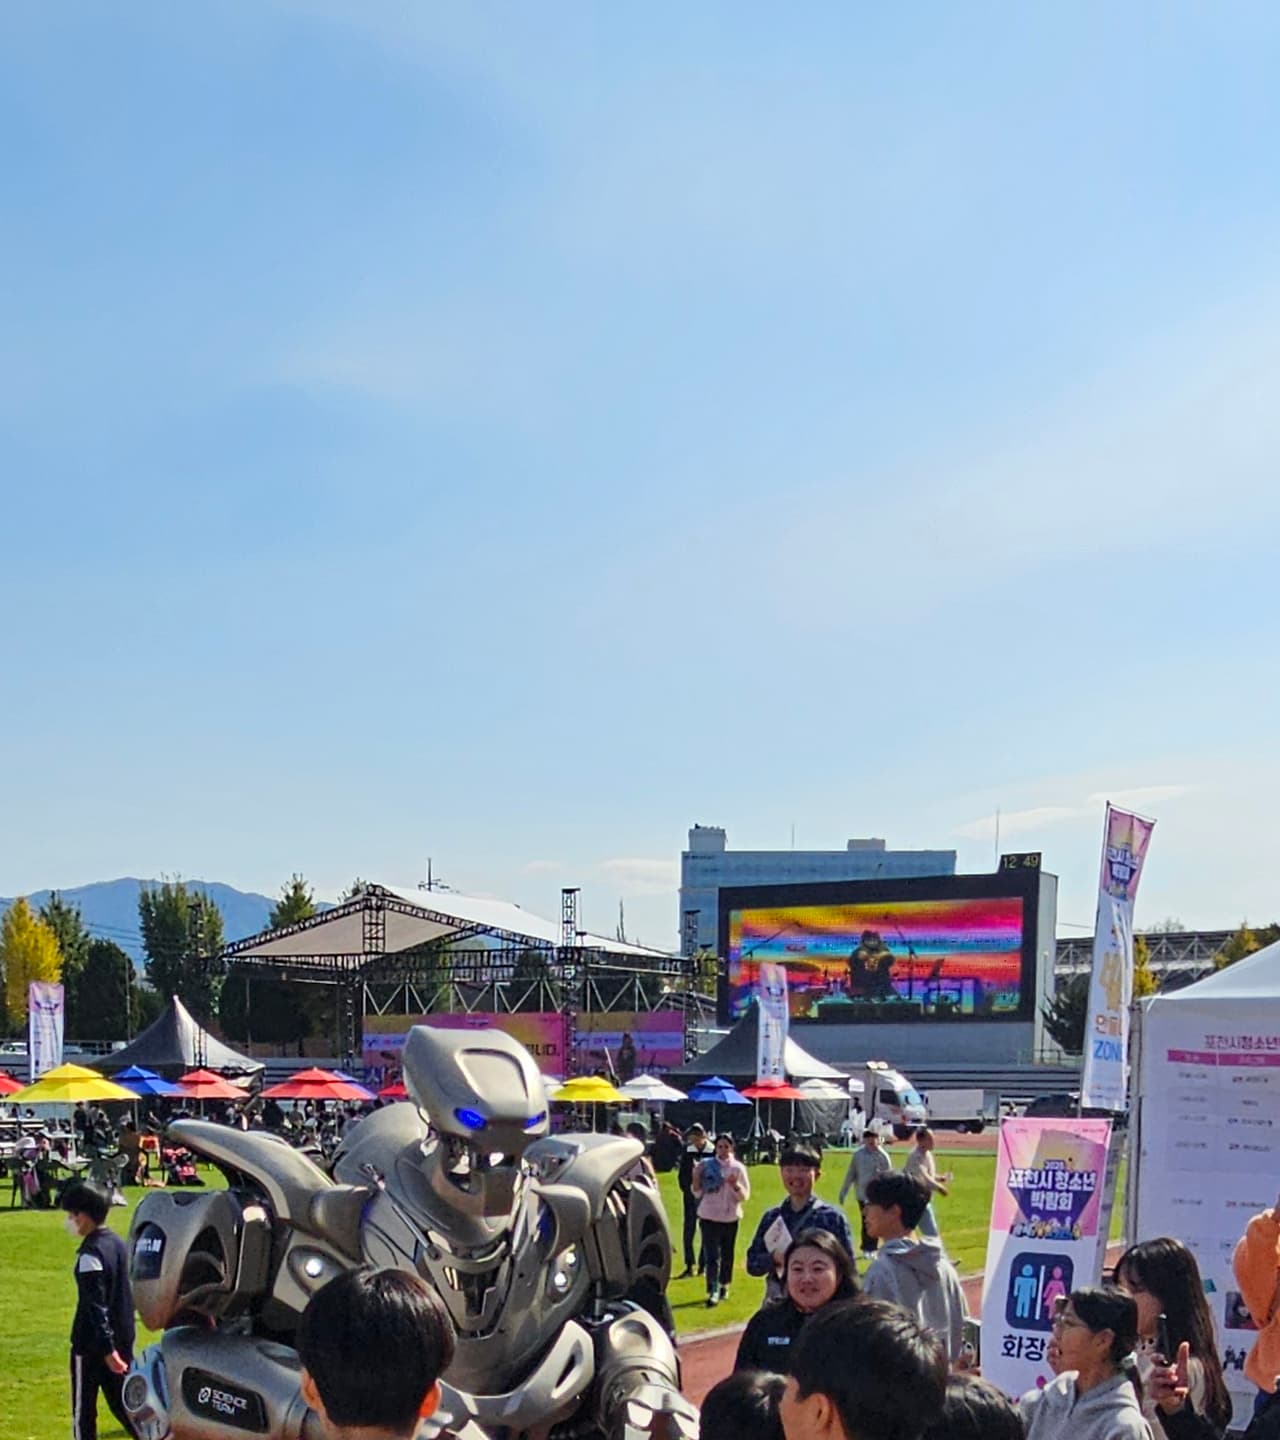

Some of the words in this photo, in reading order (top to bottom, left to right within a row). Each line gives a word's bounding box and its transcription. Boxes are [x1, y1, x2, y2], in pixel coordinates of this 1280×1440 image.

[1003, 856, 1017, 869] 12
[1008, 1169, 1053, 1190] 포천시
[1055, 1170, 1096, 1192] 청소년
[1030, 1190, 1073, 1212] 박람회
[1001, 1333, 1044, 1361] 화장
[211, 1399, 236, 1416] TEAM
[212, 1389, 248, 1410] SCIENCE
